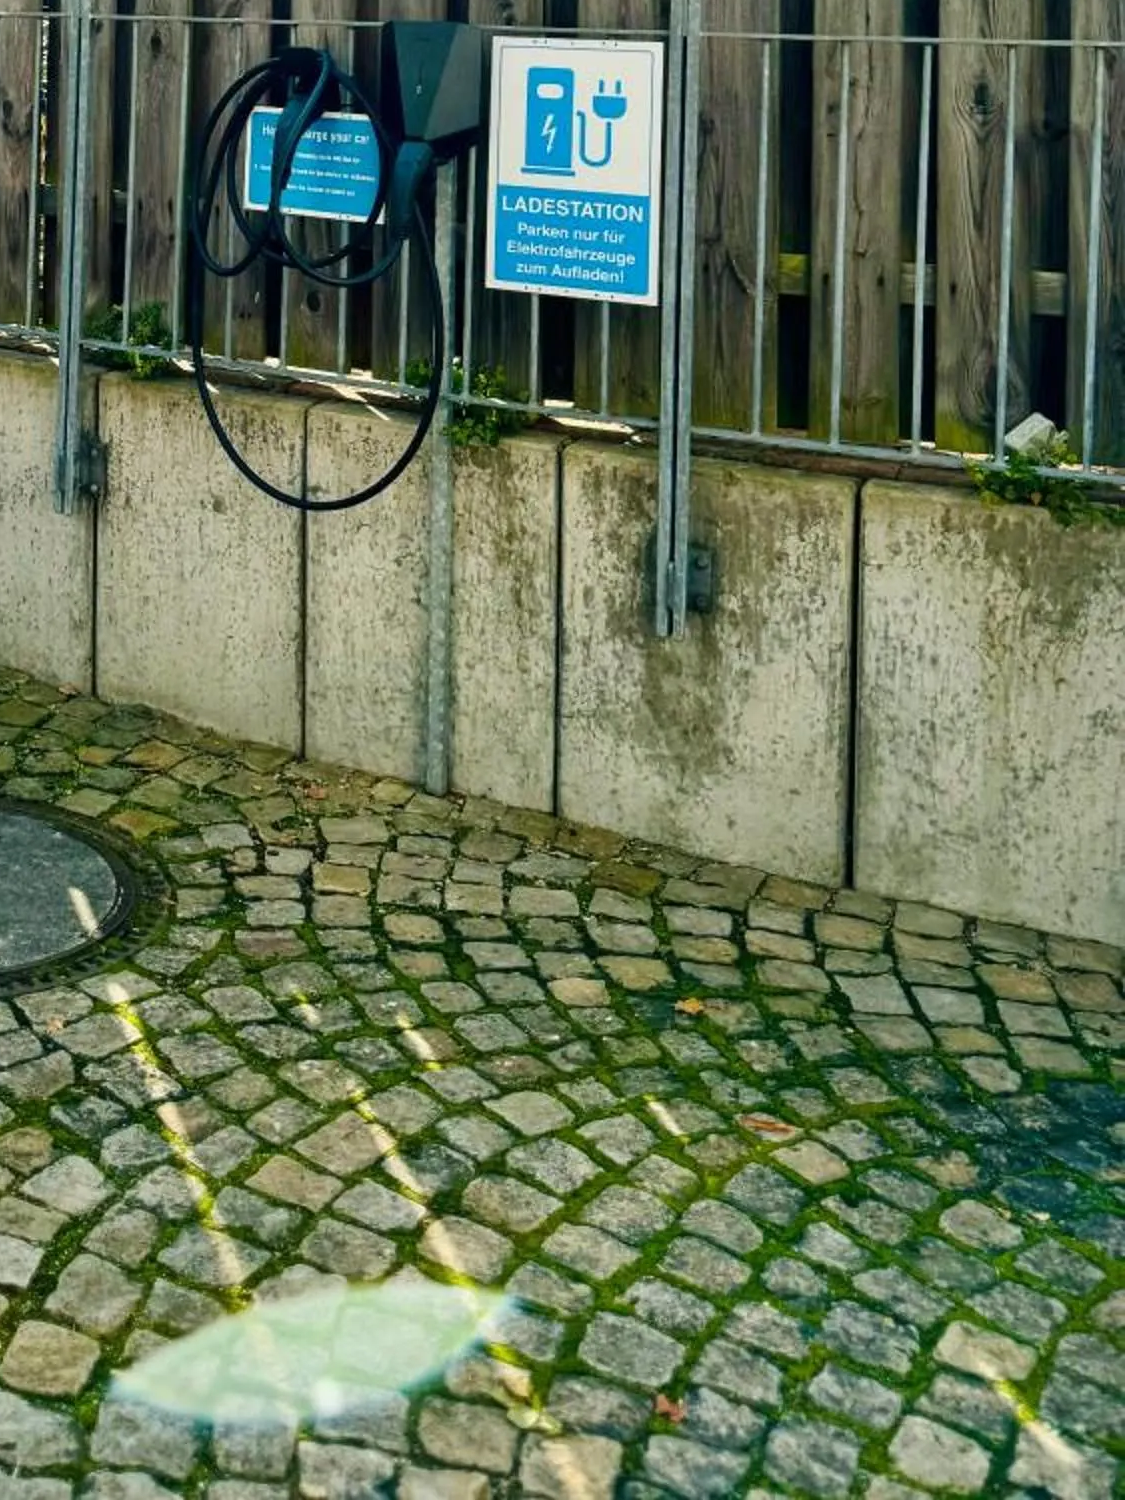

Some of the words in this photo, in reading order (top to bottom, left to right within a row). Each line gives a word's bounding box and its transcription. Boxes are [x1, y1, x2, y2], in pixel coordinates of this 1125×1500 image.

[502, 195, 644, 223] LADESTATION
[518, 221, 569, 239] Parken
[573, 229, 599, 241] nur
[603, 229, 626, 244] für
[506, 239, 636, 267] Elektrofahrzeuge
[516, 263, 546, 276] zum
[550, 263, 625, 285] Aufladen!
